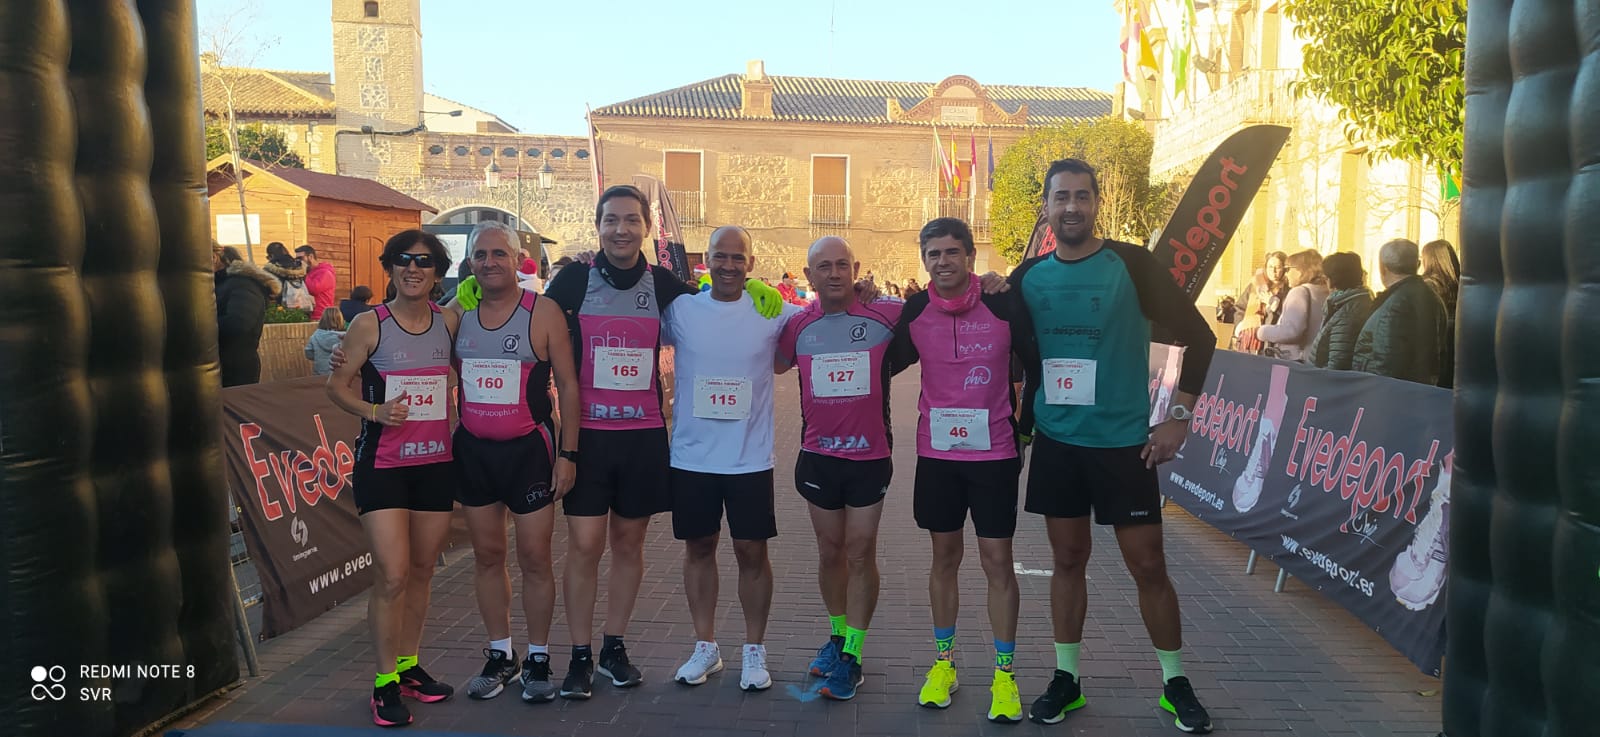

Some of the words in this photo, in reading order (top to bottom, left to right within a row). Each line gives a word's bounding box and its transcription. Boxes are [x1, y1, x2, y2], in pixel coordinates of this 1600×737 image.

[611, 365, 639, 377] 165
[827, 370, 855, 382] 127
[475, 377, 504, 389] 160
[1056, 377, 1073, 389] 16
[406, 394, 434, 407] 134
[709, 393, 737, 406] 115
[949, 426, 968, 438] 46
[1286, 396, 1440, 533] Evedeport
[1169, 471, 1225, 511] www.evedeport.es
